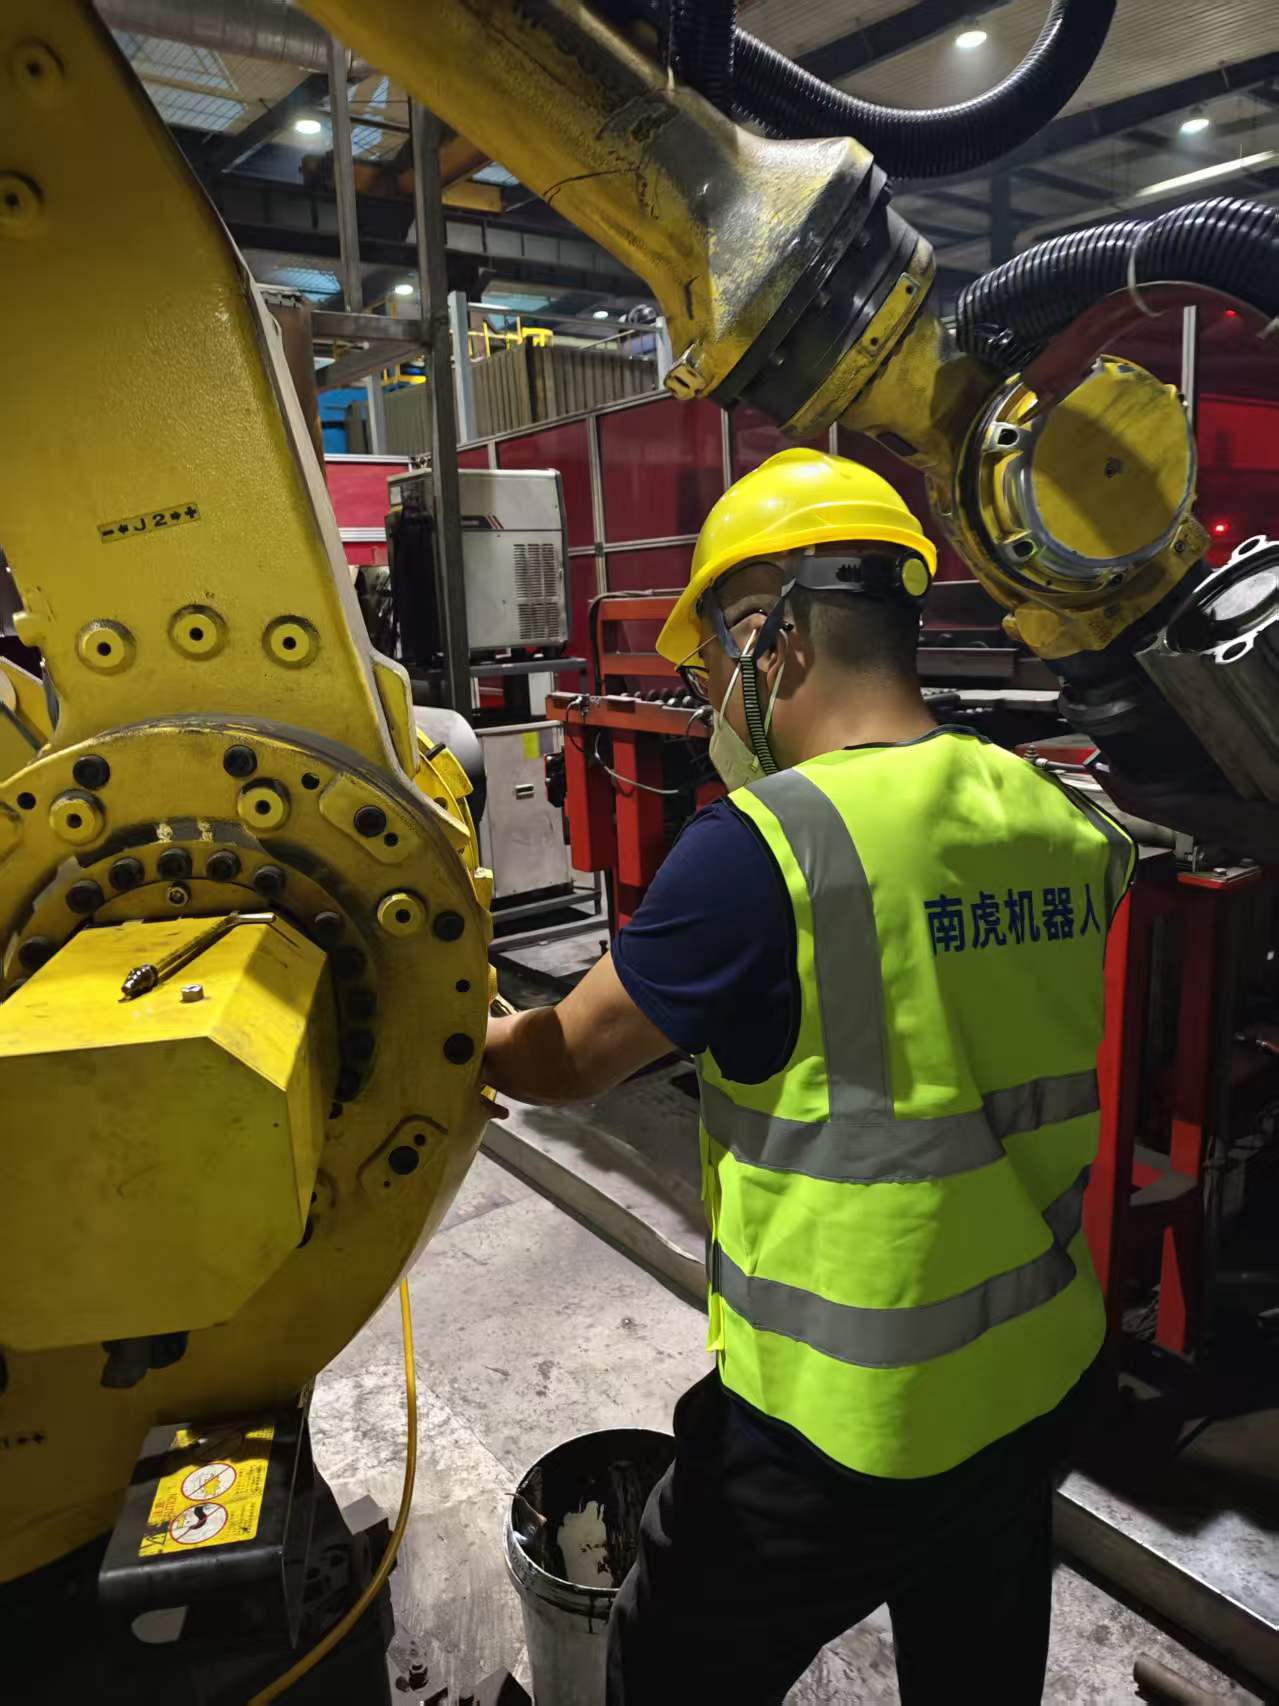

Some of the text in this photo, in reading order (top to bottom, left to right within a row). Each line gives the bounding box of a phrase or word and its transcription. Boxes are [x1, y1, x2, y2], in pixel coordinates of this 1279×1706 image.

[924, 883, 1101, 955] 南虎机器人
